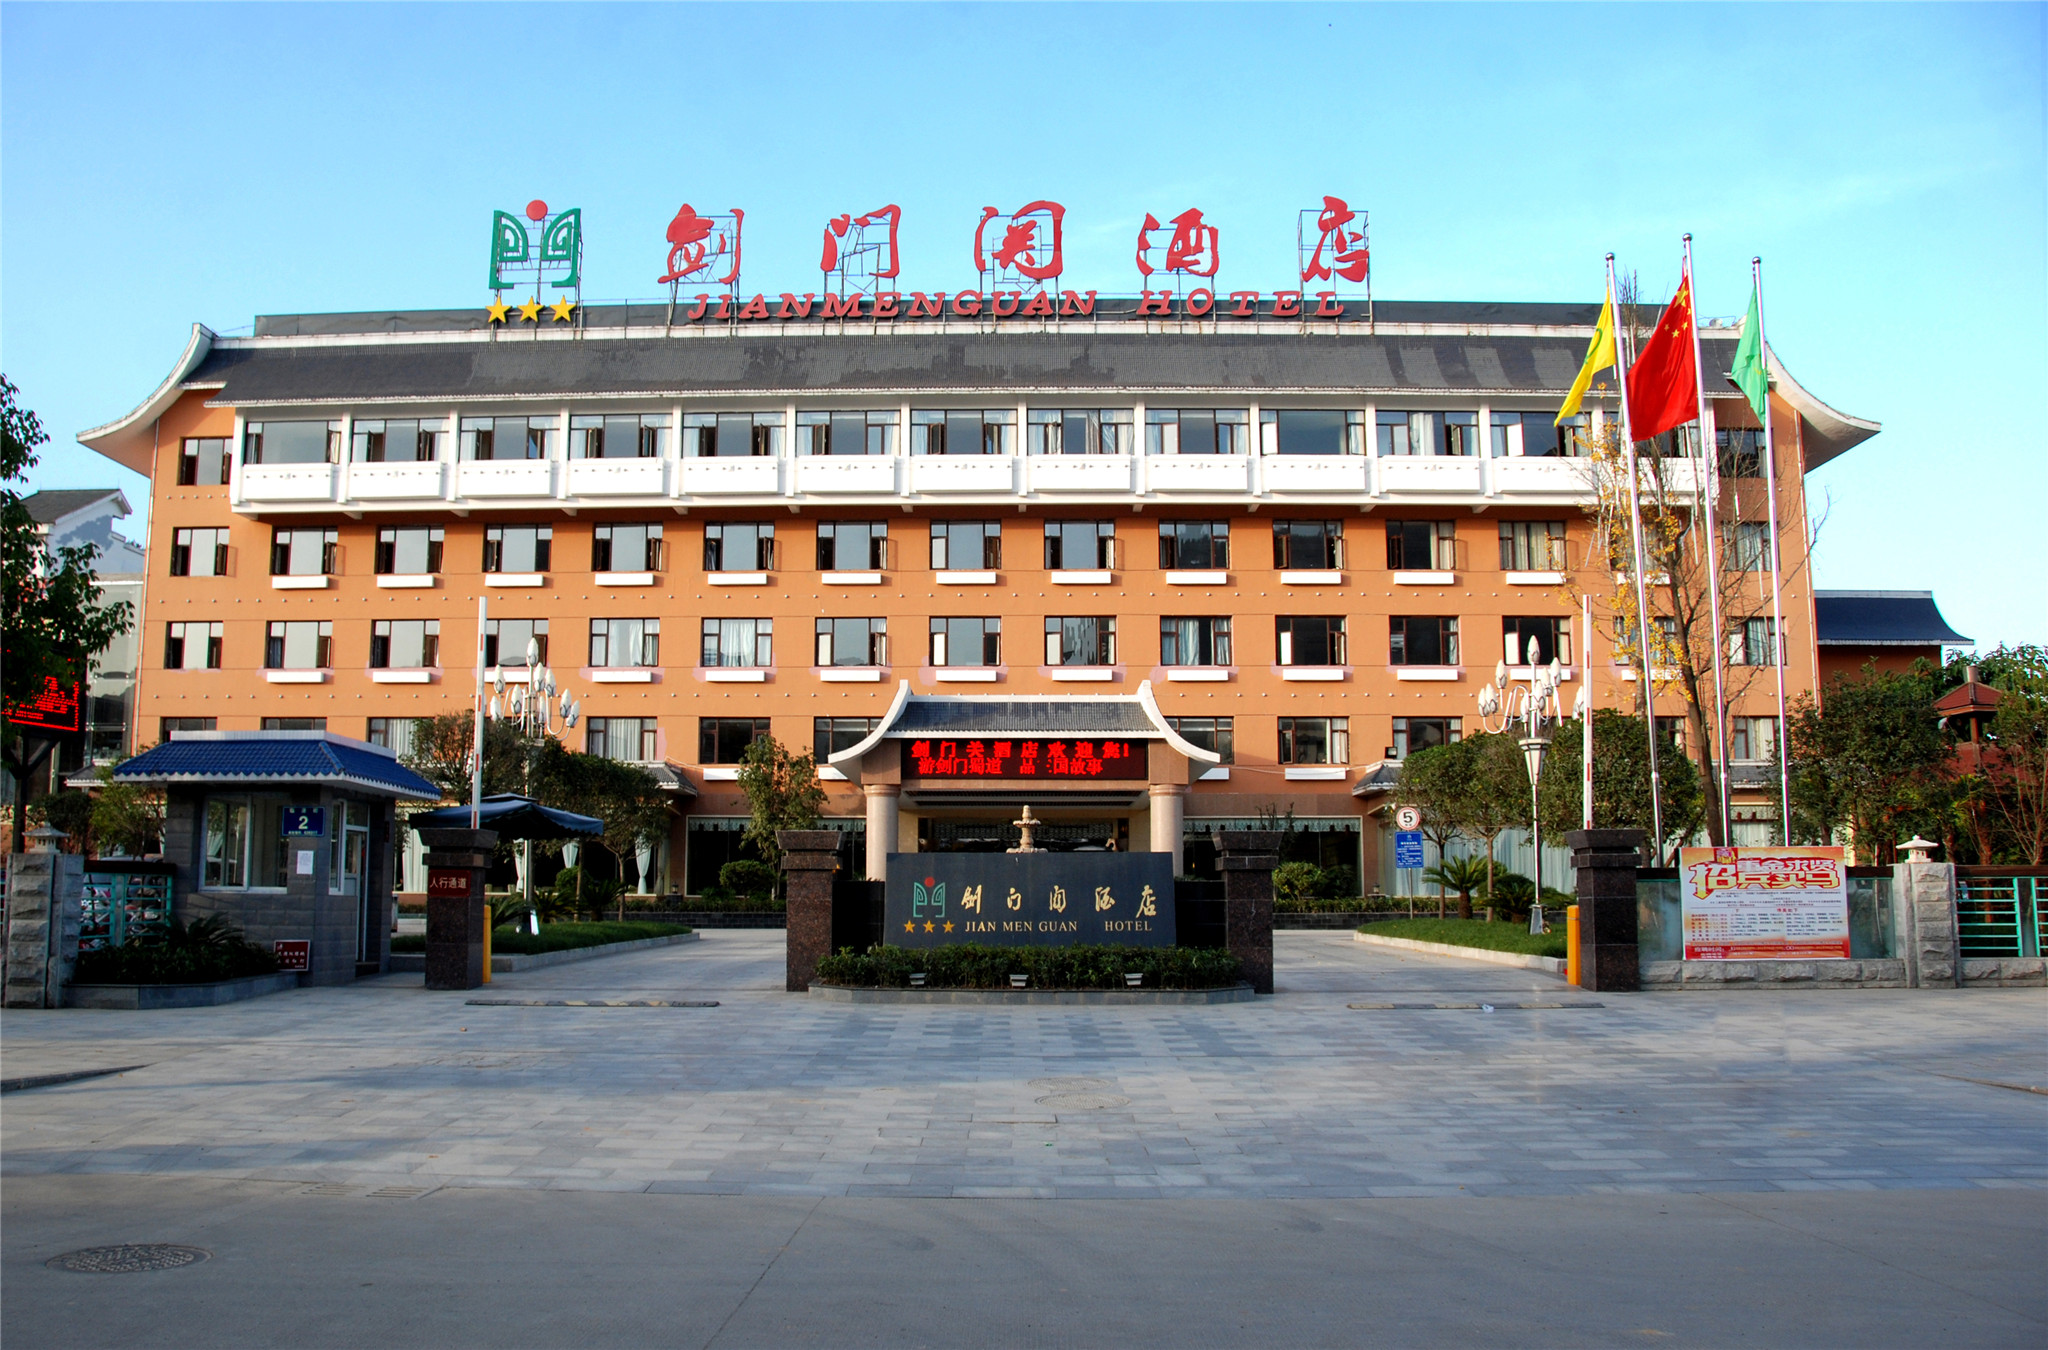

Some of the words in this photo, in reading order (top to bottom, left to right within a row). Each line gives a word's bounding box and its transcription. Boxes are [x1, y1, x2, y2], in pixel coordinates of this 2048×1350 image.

[687, 290, 1097, 320] JIANMENGUAN
[1136, 288, 1344, 318] HOTEL
[298, 815, 309, 830] 2
[1403, 812, 1413, 823] 5
[429, 876, 467, 889] 人行通道
[964, 920, 997, 932] JIAN
[1002, 920, 1034, 932] MEN
[1038, 920, 1078, 932] GUAN
[1104, 920, 1152, 932] HOTEL
